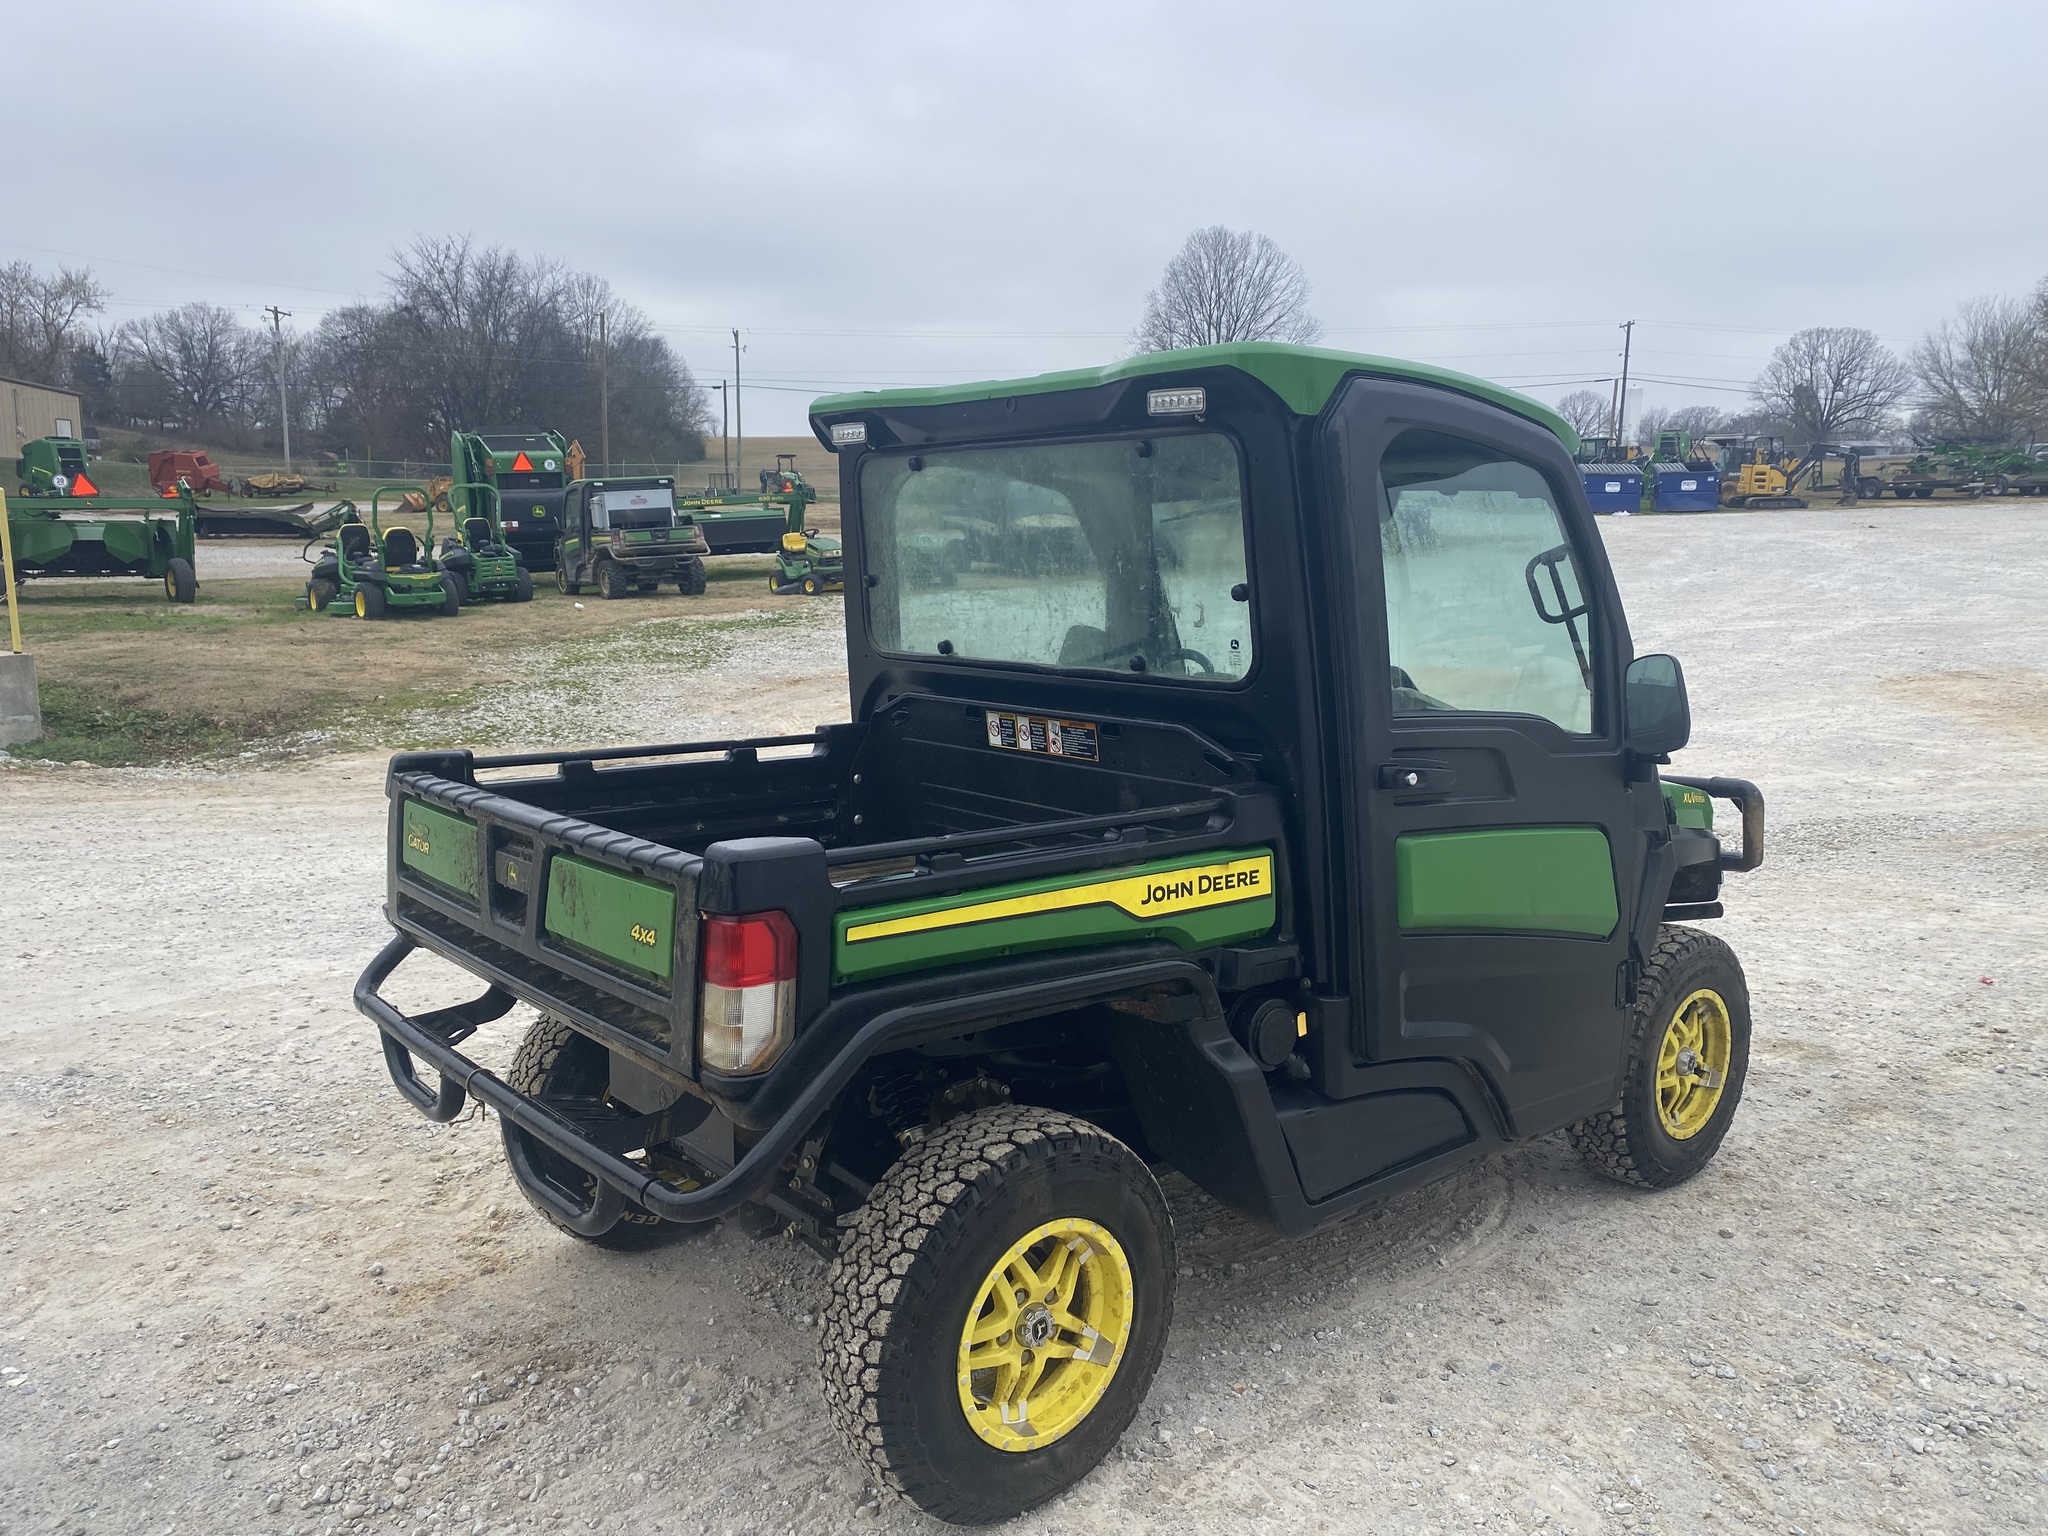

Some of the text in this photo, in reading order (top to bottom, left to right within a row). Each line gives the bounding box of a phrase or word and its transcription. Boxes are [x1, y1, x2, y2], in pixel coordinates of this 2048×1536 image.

[408, 833, 430, 855] GATOR
[1141, 869, 1260, 905] JOHN DEERE
